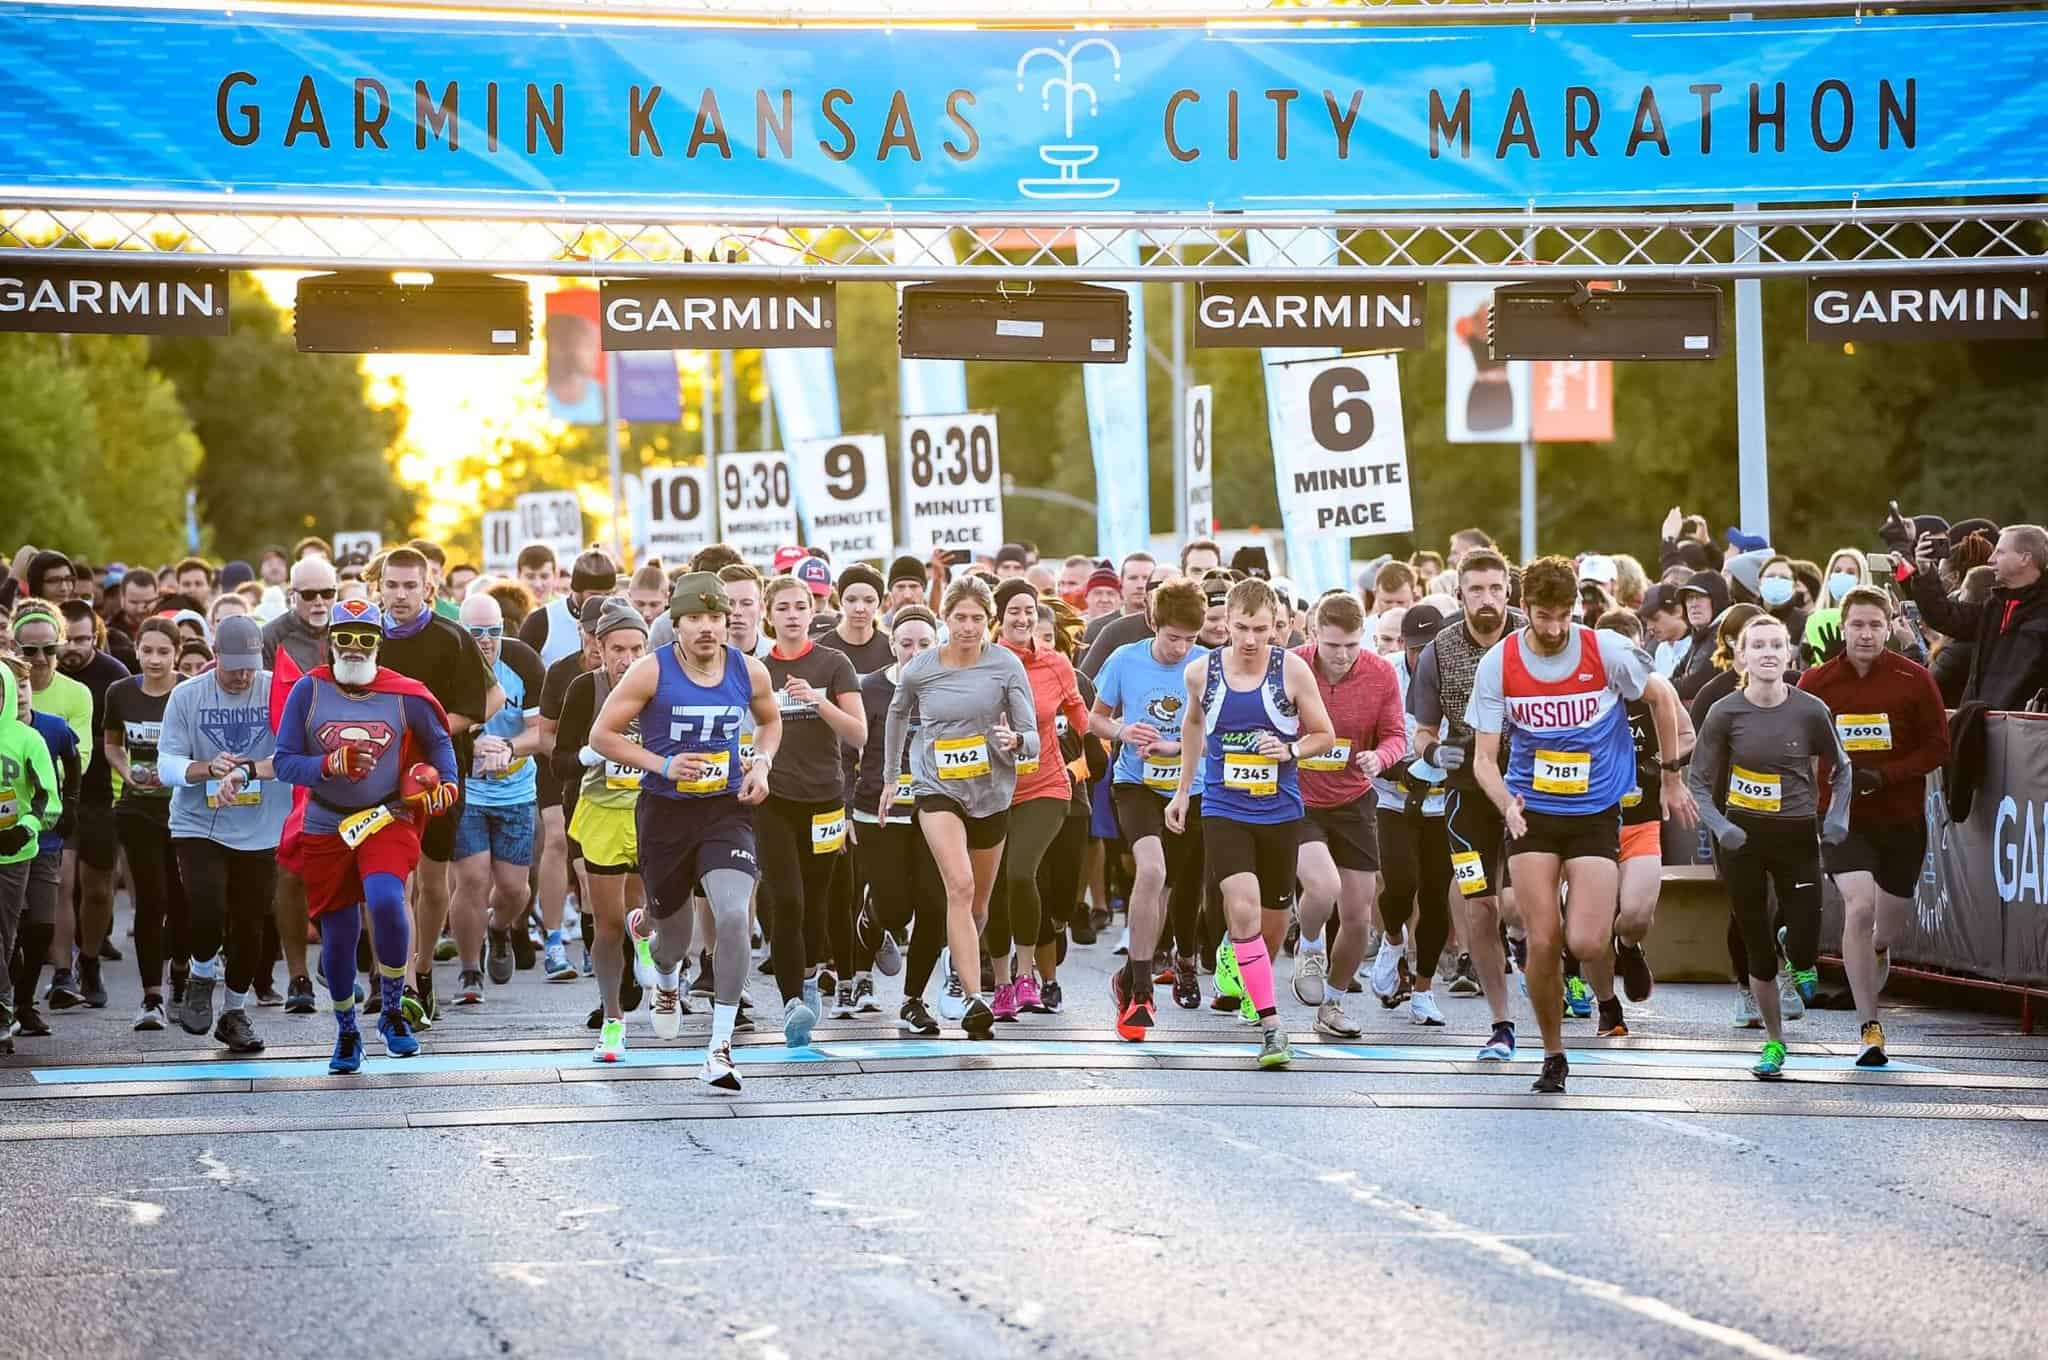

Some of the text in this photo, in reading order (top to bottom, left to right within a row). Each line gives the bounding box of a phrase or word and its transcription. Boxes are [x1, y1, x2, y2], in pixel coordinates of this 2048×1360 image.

[216, 71, 1918, 162] GARMIN KANSAS CITY MARATHON
[0, 277, 215, 318] GARMIN
[1199, 295, 1413, 329] GARMIN
[1813, 287, 2031, 325] GARMIN
[605, 297, 823, 333] GARMIN
[1308, 366, 1375, 453] 6
[824, 443, 867, 501] 9
[910, 425, 993, 488] 8:30
[724, 461, 790, 510] 9:30
[1294, 462, 1402, 494] MINUTE
[651, 475, 702, 522] 10
[915, 497, 997, 518] MINUTE
[1317, 501, 1387, 529] PACE
[814, 510, 887, 528] MINUTE
[931, 526, 983, 545] PACE
[493, 519, 511, 555] 11
[830, 535, 875, 553] PACE
[1844, 727, 1883, 737] 7690
[943, 750, 979, 765] 7162
[1232, 767, 1270, 780] 7345
[1545, 764, 1578, 778] 7181
[1737, 780, 1772, 797] 7695
[1993, 794, 2048, 905] GA
